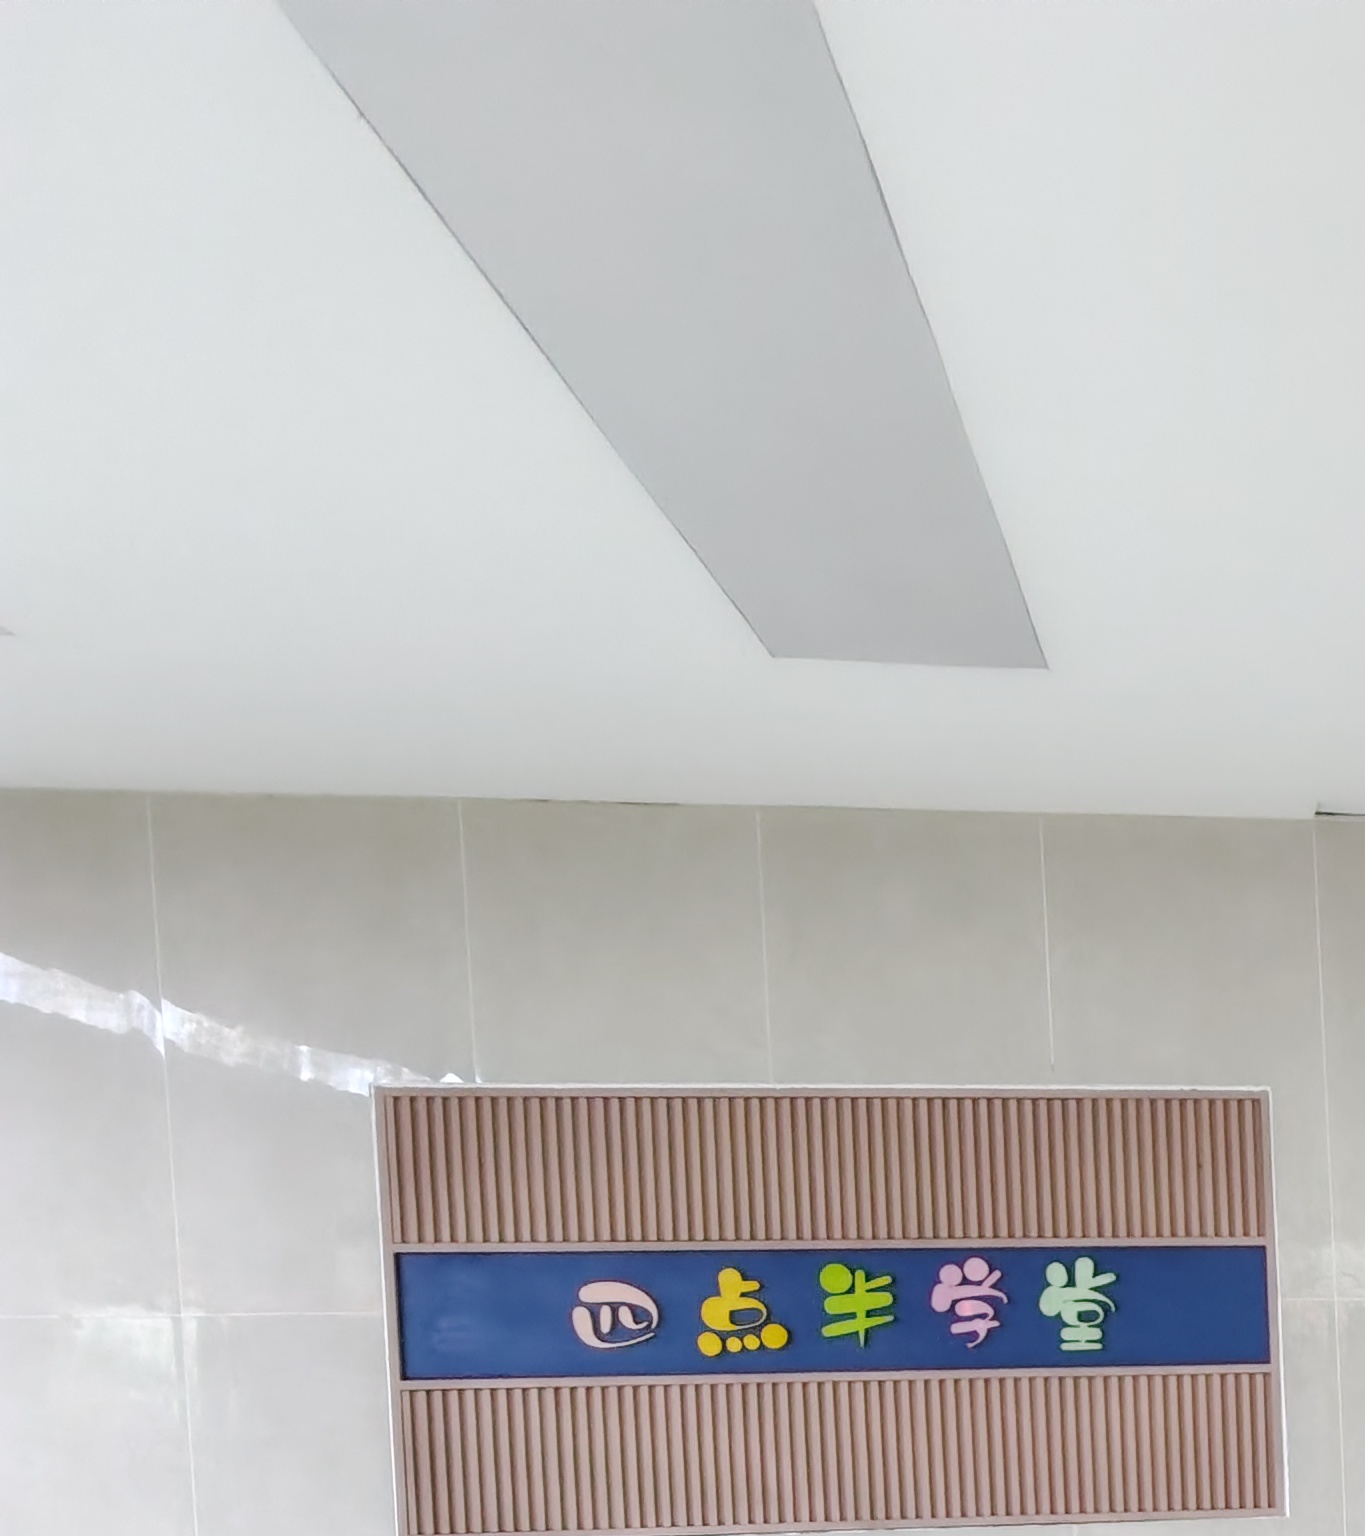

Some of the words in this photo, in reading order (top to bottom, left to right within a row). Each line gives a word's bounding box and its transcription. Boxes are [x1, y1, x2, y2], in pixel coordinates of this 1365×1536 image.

[572, 1257, 1117, 1357] 四点半学堂
